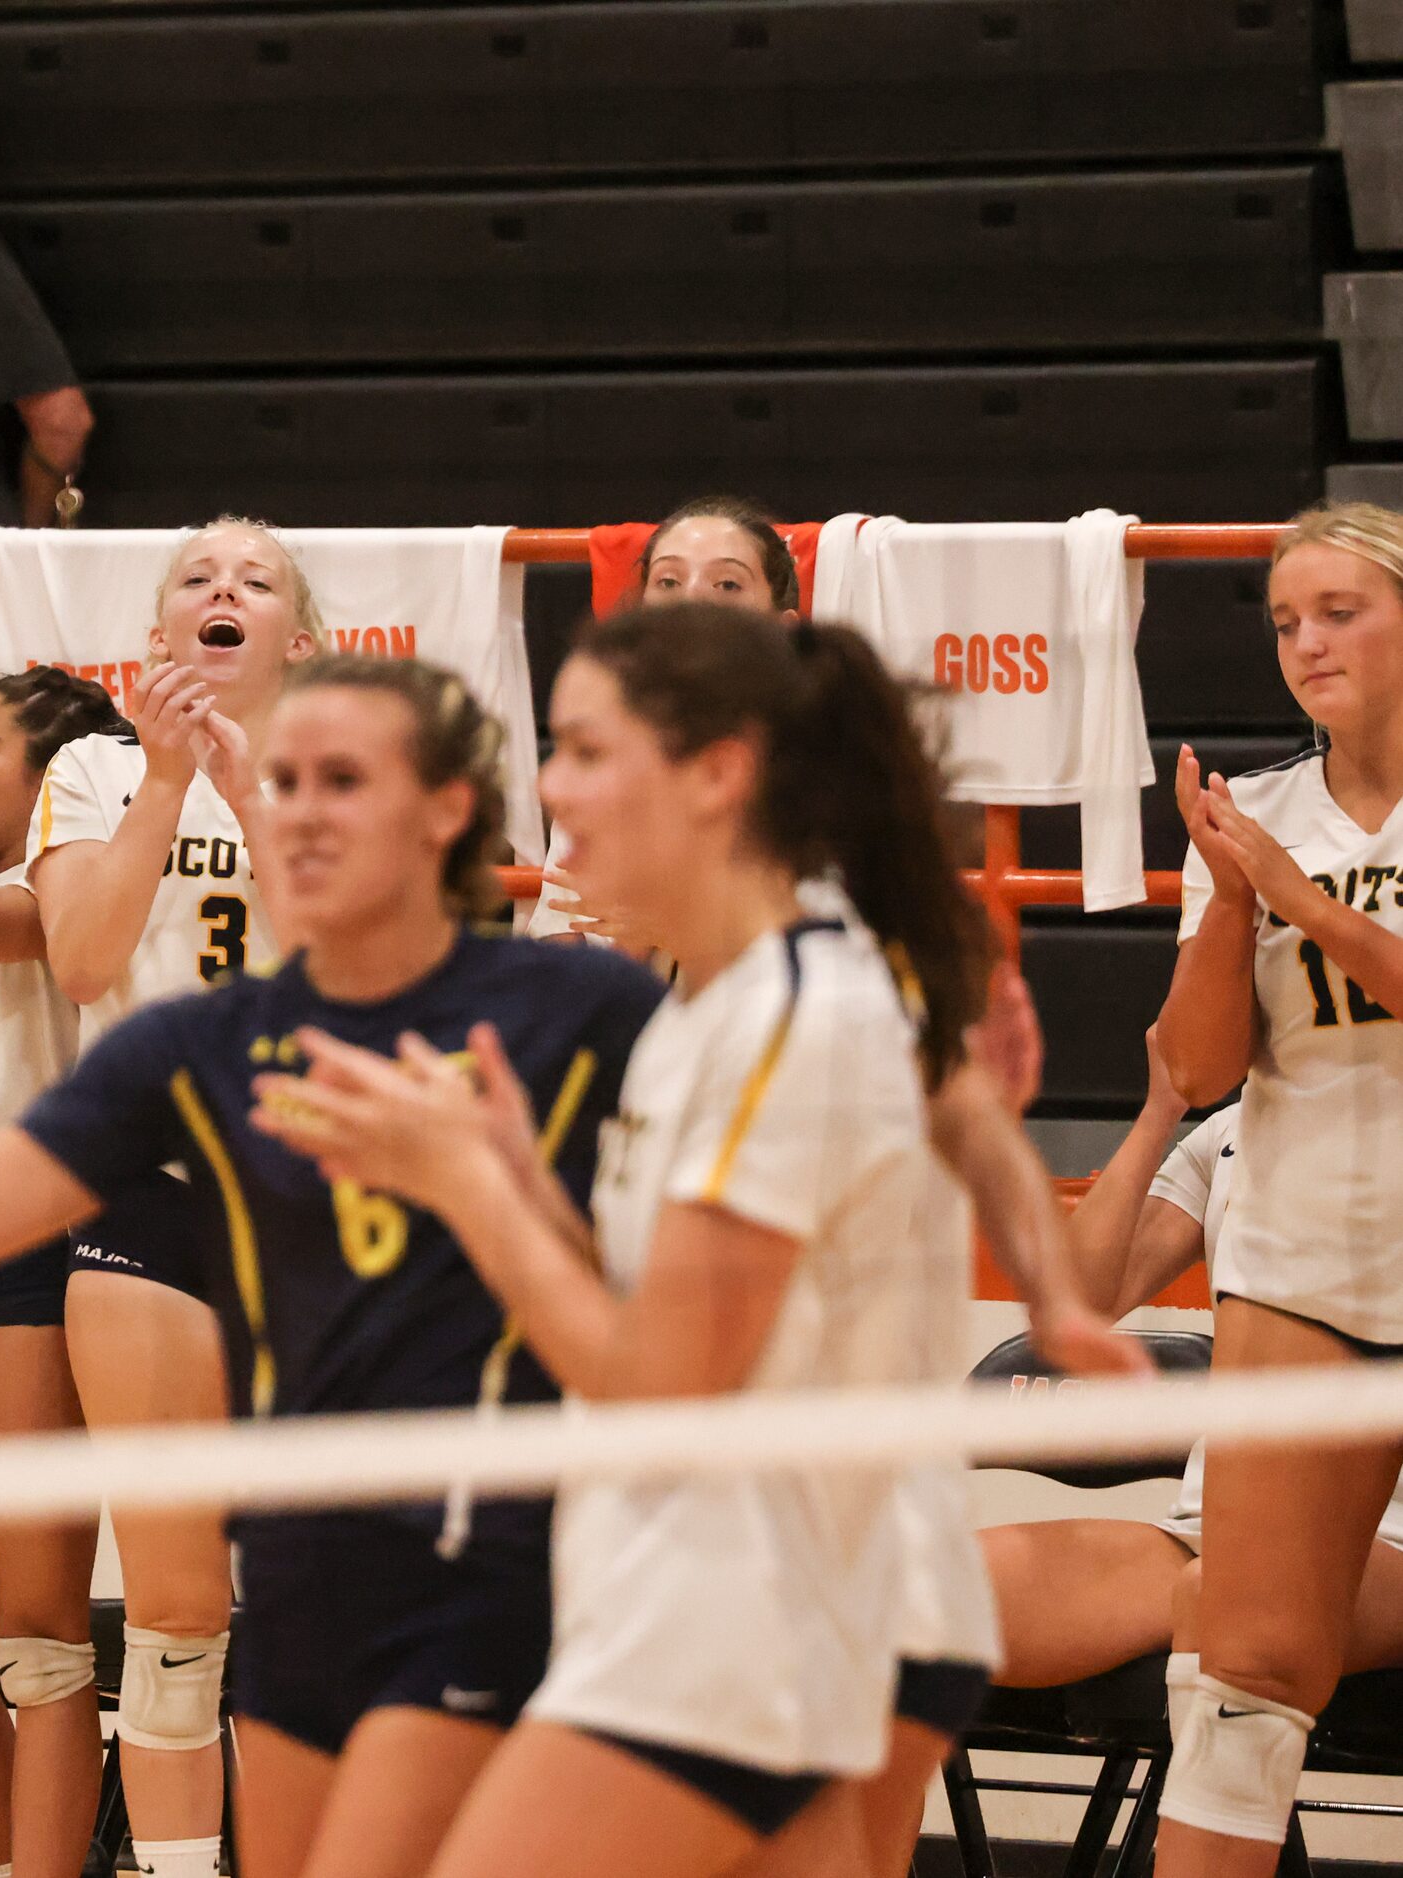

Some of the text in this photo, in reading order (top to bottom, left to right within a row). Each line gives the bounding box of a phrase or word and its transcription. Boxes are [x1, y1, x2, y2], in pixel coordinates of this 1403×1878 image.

[933, 632, 1048, 694] GOSS
[197, 892, 249, 986] 3
[331, 1175, 409, 1279] 6
